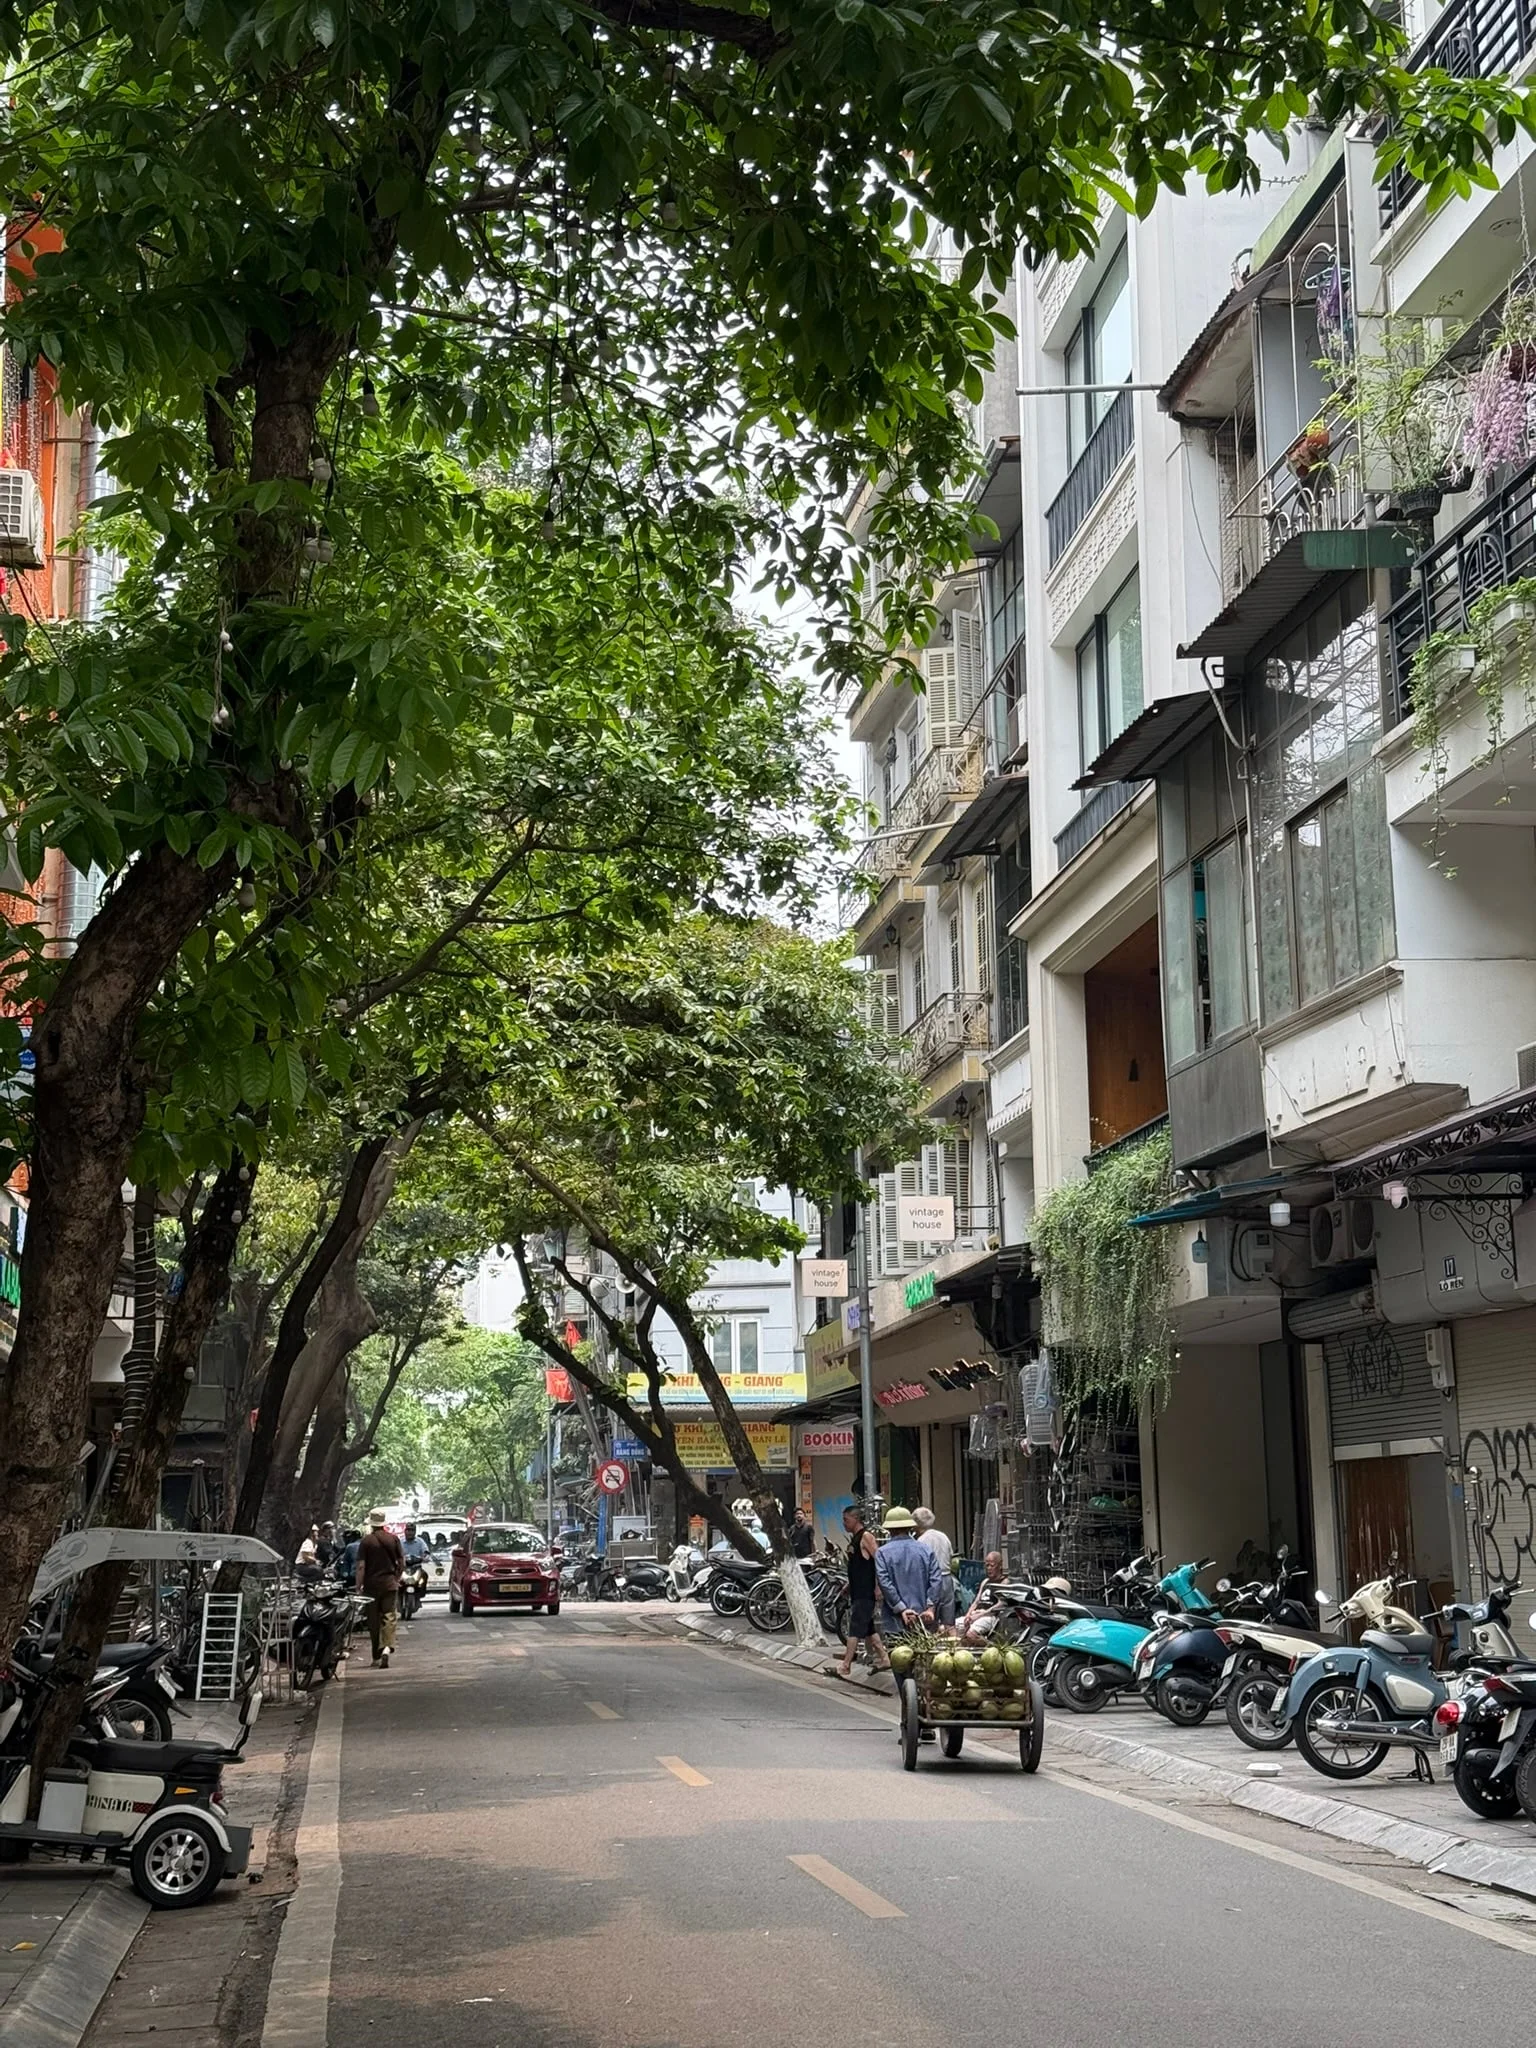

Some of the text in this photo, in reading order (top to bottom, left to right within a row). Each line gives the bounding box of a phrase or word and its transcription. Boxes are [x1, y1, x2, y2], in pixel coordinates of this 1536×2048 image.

[909, 1207, 944, 1218] vintage
[912, 1220, 941, 1229] house
[1446, 1259, 1454, 1275] 17
[811, 1269, 840, 1278] vintage
[813, 1279, 838, 1288] house
[743, 1375, 783, 1387] GIANG
[88, 1795, 133, 1812] HINATA
